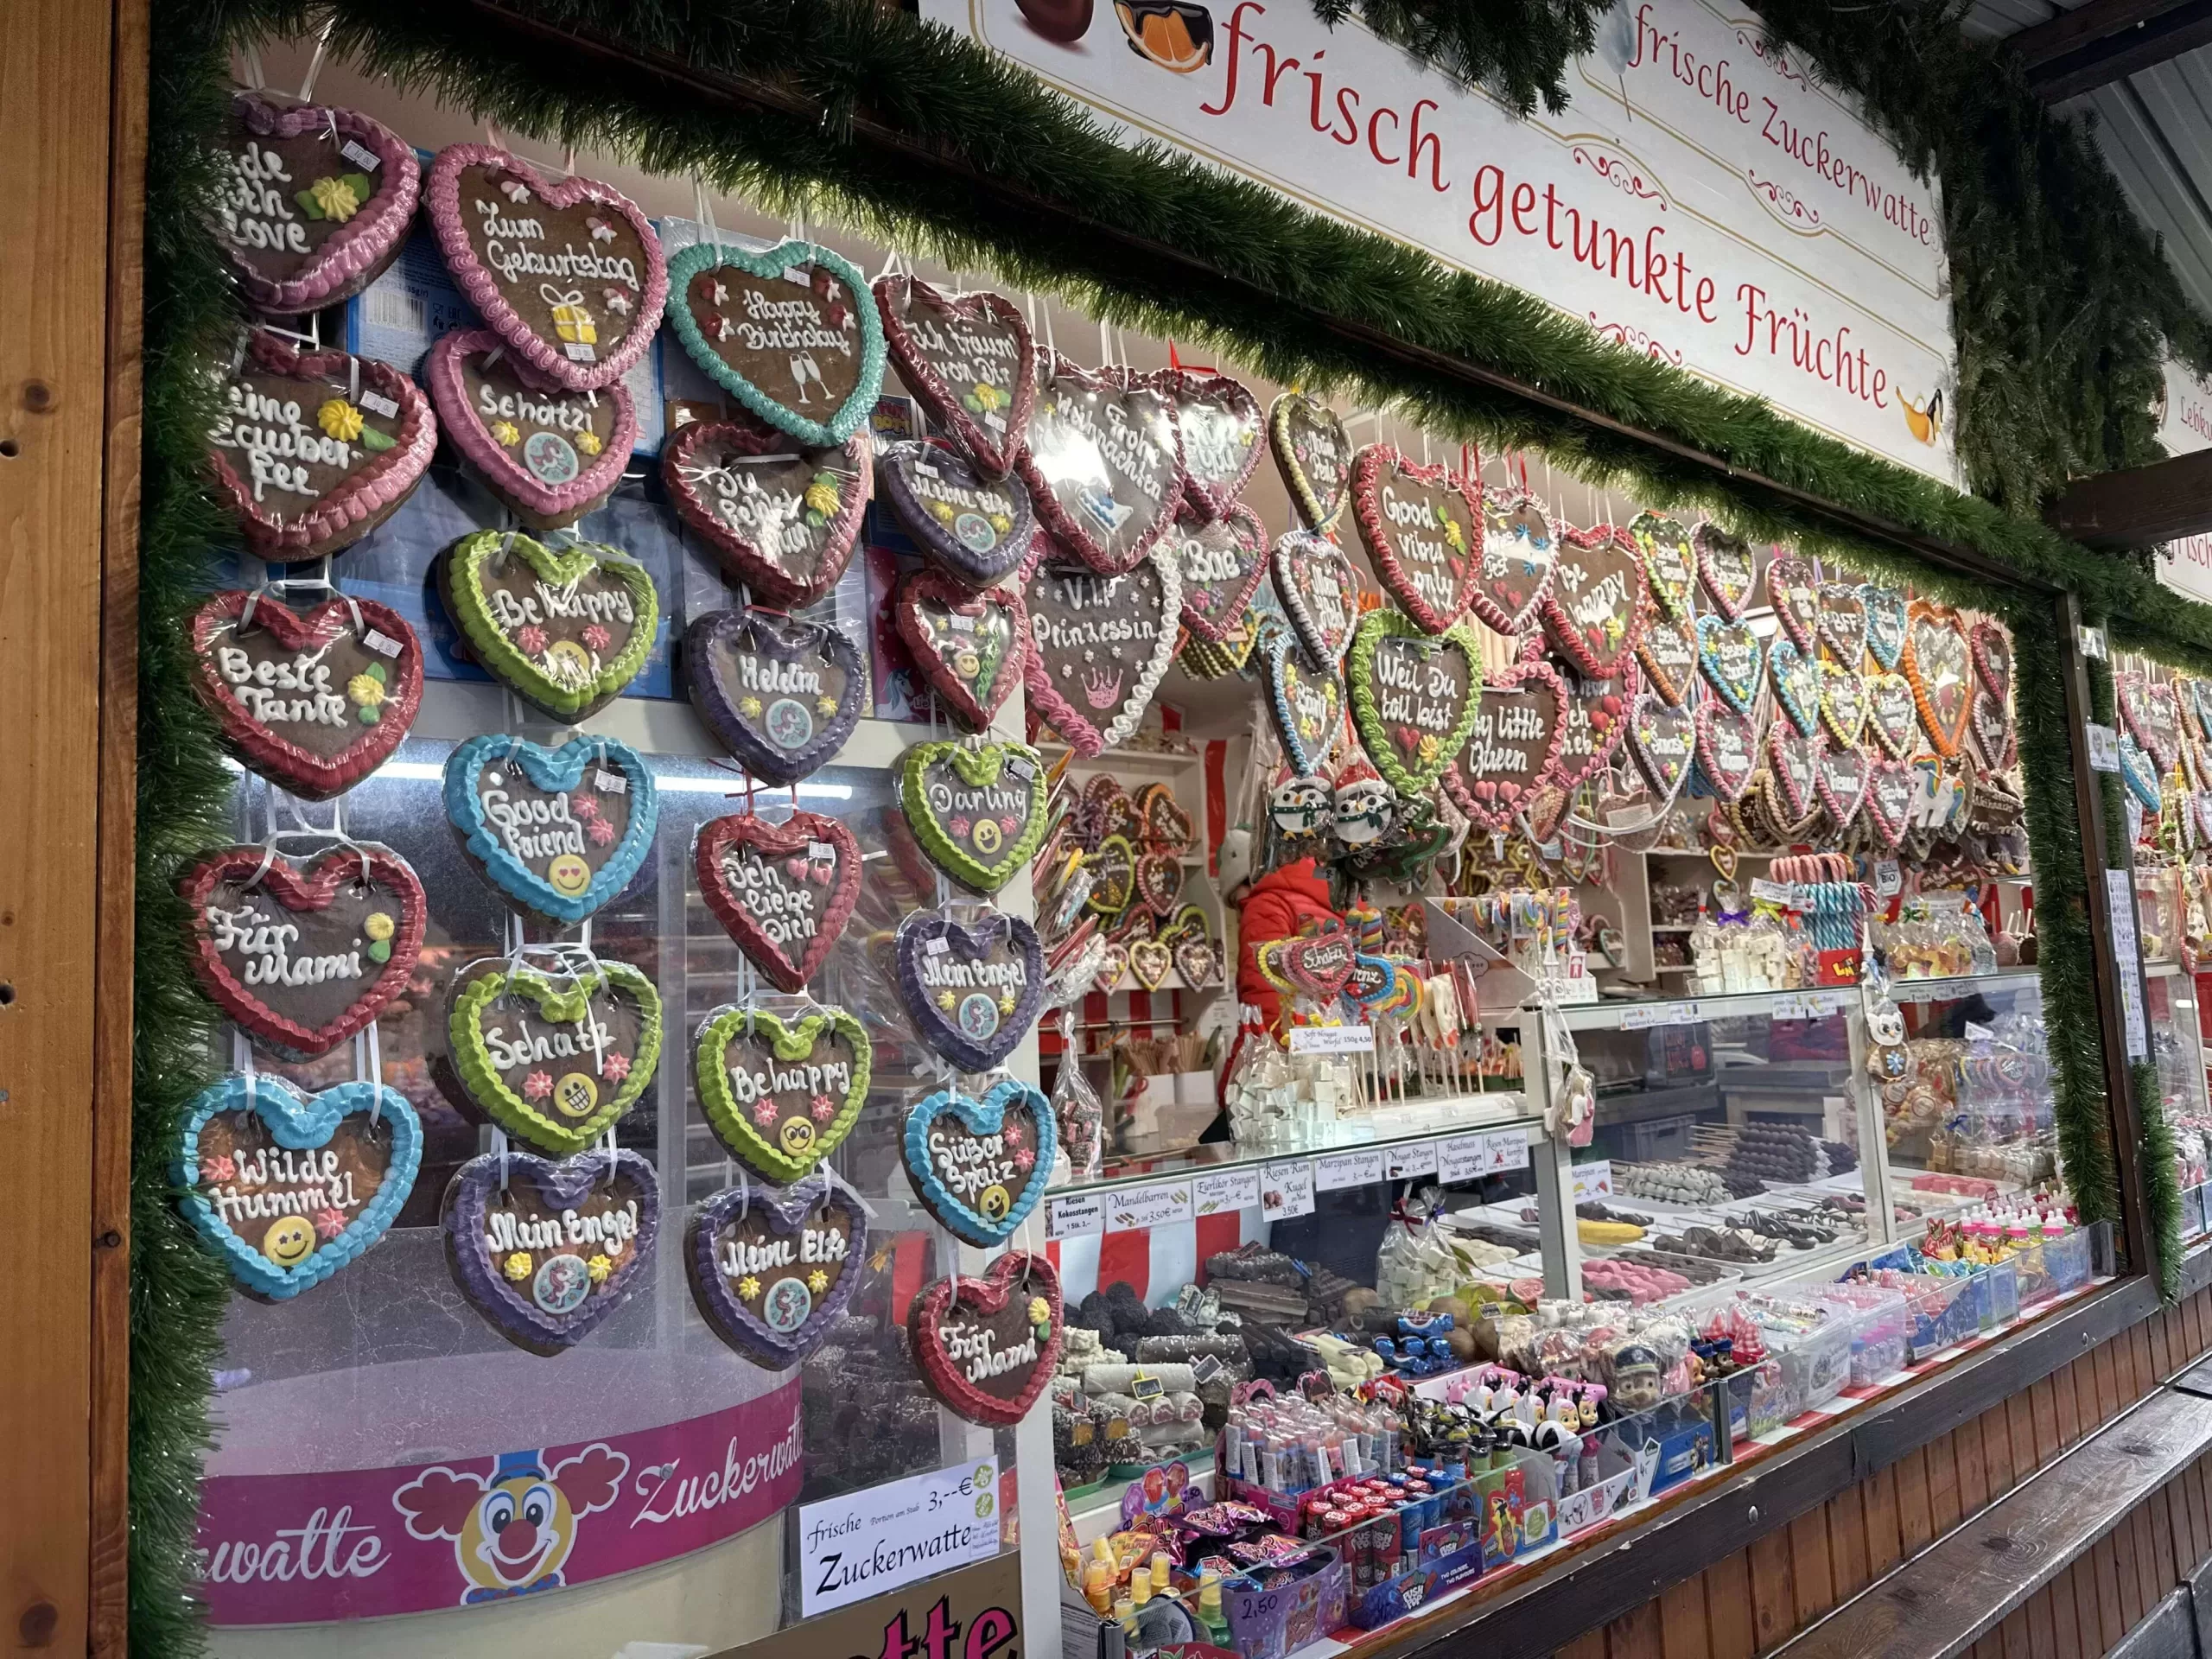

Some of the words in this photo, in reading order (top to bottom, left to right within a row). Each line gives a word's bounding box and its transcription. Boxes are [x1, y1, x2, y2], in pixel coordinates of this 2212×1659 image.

[1627, 4, 1751, 124] frische
[1761, 97, 1930, 246] Zuckerwatte
[476, 199, 544, 239] Zum
[1199, 2, 1451, 193] frisch
[1469, 165, 1717, 323] getunkte
[1735, 283, 1888, 410] Früchte
[486, 240, 639, 290] Geburtstag
[744, 289, 820, 326] Happy
[737, 326, 850, 357] Birthday
[901, 319, 945, 351] Ich
[949, 323, 1019, 361] träum
[937, 359, 977, 384] von
[976, 355, 1011, 386] Dir
[477, 385, 594, 432] Schatzi
[912, 474, 976, 510] Meine
[977, 483, 1014, 516] Elfe
[1382, 486, 1439, 531] Good
[493, 588, 540, 628] Be
[1412, 565, 1454, 613] only
[1566, 569, 1630, 626] happy
[1032, 613, 1158, 653] Prinzessin
[1830, 611, 1857, 633] BFF
[219, 646, 333, 692] Beste
[739, 655, 823, 696] Heldin
[1376, 651, 1423, 694] Weil
[1427, 665, 1459, 700] Du
[234, 685, 349, 728] Tante
[1381, 689, 1414, 725] toll
[1415, 696, 1454, 731] bist
[1498, 705, 1545, 741] little
[1469, 741, 1529, 779] Queen
[481, 789, 572, 827] Good
[929, 779, 1027, 818] Darling
[724, 855, 780, 891] Ich
[743, 887, 814, 921] liebe
[206, 904, 299, 954] Für
[762, 914, 818, 944] Dich
[244, 937, 363, 987] Mami
[922, 956, 973, 989] Mein
[973, 956, 1027, 997] Engel
[485, 1020, 617, 1071] Schatz
[730, 1061, 772, 1104] Be
[767, 1055, 849, 1096] happy
[233, 1147, 341, 1185] Wilde
[929, 1131, 1006, 1170] Süßer
[1316, 1158, 1352, 1173] Marzipan
[1353, 1154, 1379, 1167] Stangen
[1387, 1150, 1411, 1164] Nougat
[1412, 1147, 1433, 1160] Stangen
[944, 1160, 1018, 1205] Spatz
[1197, 1178, 1229, 1194] Eierlikör
[1230, 1173, 1257, 1189] Stangen
[1264, 1162, 1288, 1182] Riesen
[1290, 1162, 1310, 1174] Rum
[1284, 1177, 1307, 1196] Kugel
[208, 1172, 360, 1224] Hummel
[1058, 1205, 1099, 1219] Kokosstangen
[1065, 1196, 1086, 1206] Riesen
[1108, 1191, 1169, 1209] Mandelbarren
[486, 1209, 563, 1253] Mein
[563, 1198, 638, 1255] Engel
[721, 1236, 796, 1278] Meine
[799, 1227, 850, 1264] Elfe
[940, 1325, 995, 1363] Für
[966, 1327, 1038, 1383] Mami
[806, 1512, 861, 1554] frische
[816, 1524, 972, 1596] Zuckerwatte
[1441, 1571, 1450, 1580] TWO
[1243, 1594, 1278, 1620] 2,50
[1402, 1585, 1425, 1601] PUSH
[1406, 1594, 1423, 1610] POP
